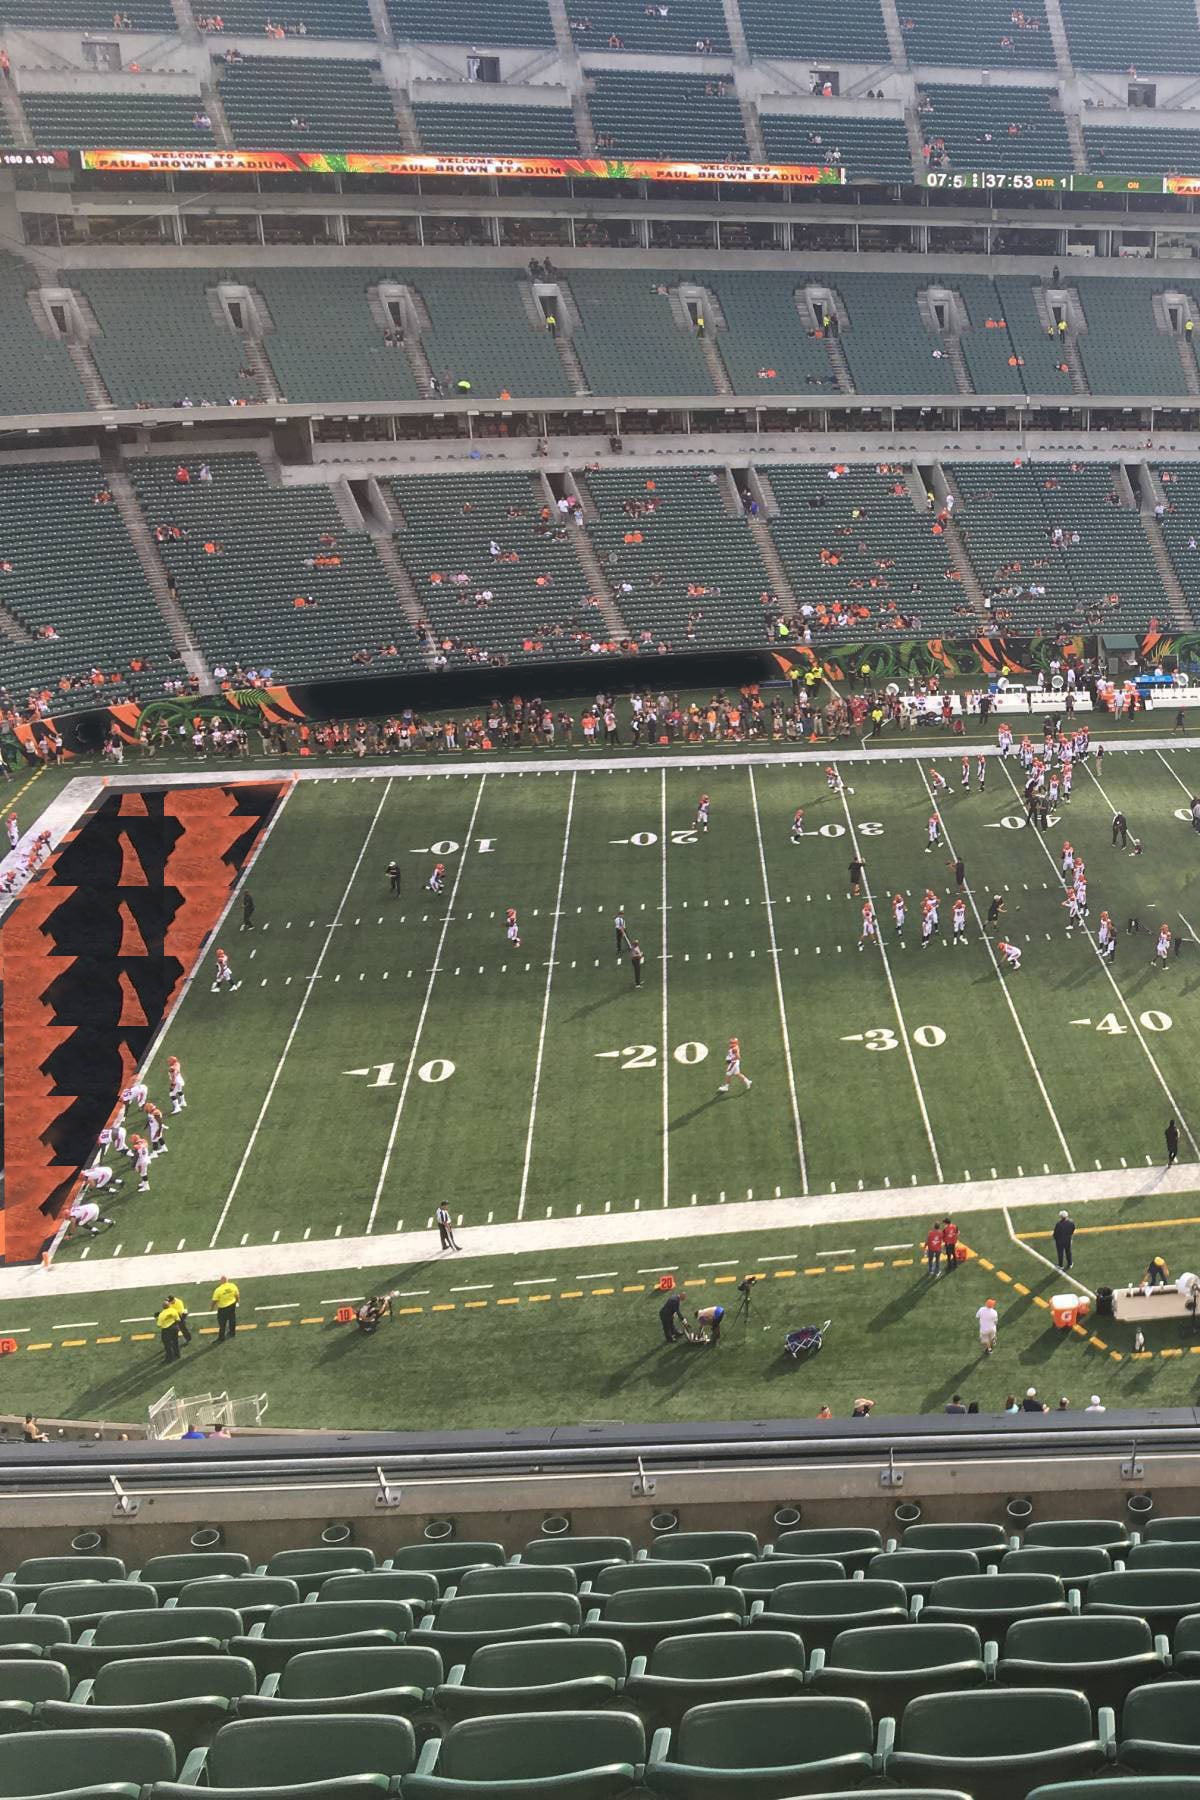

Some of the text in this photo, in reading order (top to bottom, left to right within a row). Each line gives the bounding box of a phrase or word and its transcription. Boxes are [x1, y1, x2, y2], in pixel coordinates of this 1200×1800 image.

[100, 160, 287, 169] PAUL BROWN STADIUM
[436, 165, 488, 173] BROWN
[496, 165, 561, 174] STADIUM
[753, 173, 815, 181] STADIUM
[986, 174, 1034, 188] 37:53
[1035, 178, 1054, 187] QTR
[1095, 1010, 1173, 1034] 40
[864, 1025, 947, 1051] 30
[621, 1042, 709, 1069] 20
[366, 1059, 456, 1087] 10
[661, 1277, 673, 1289] 20
[339, 1309, 350, 1320] 10
[1, 1341, 10, 1352] G
